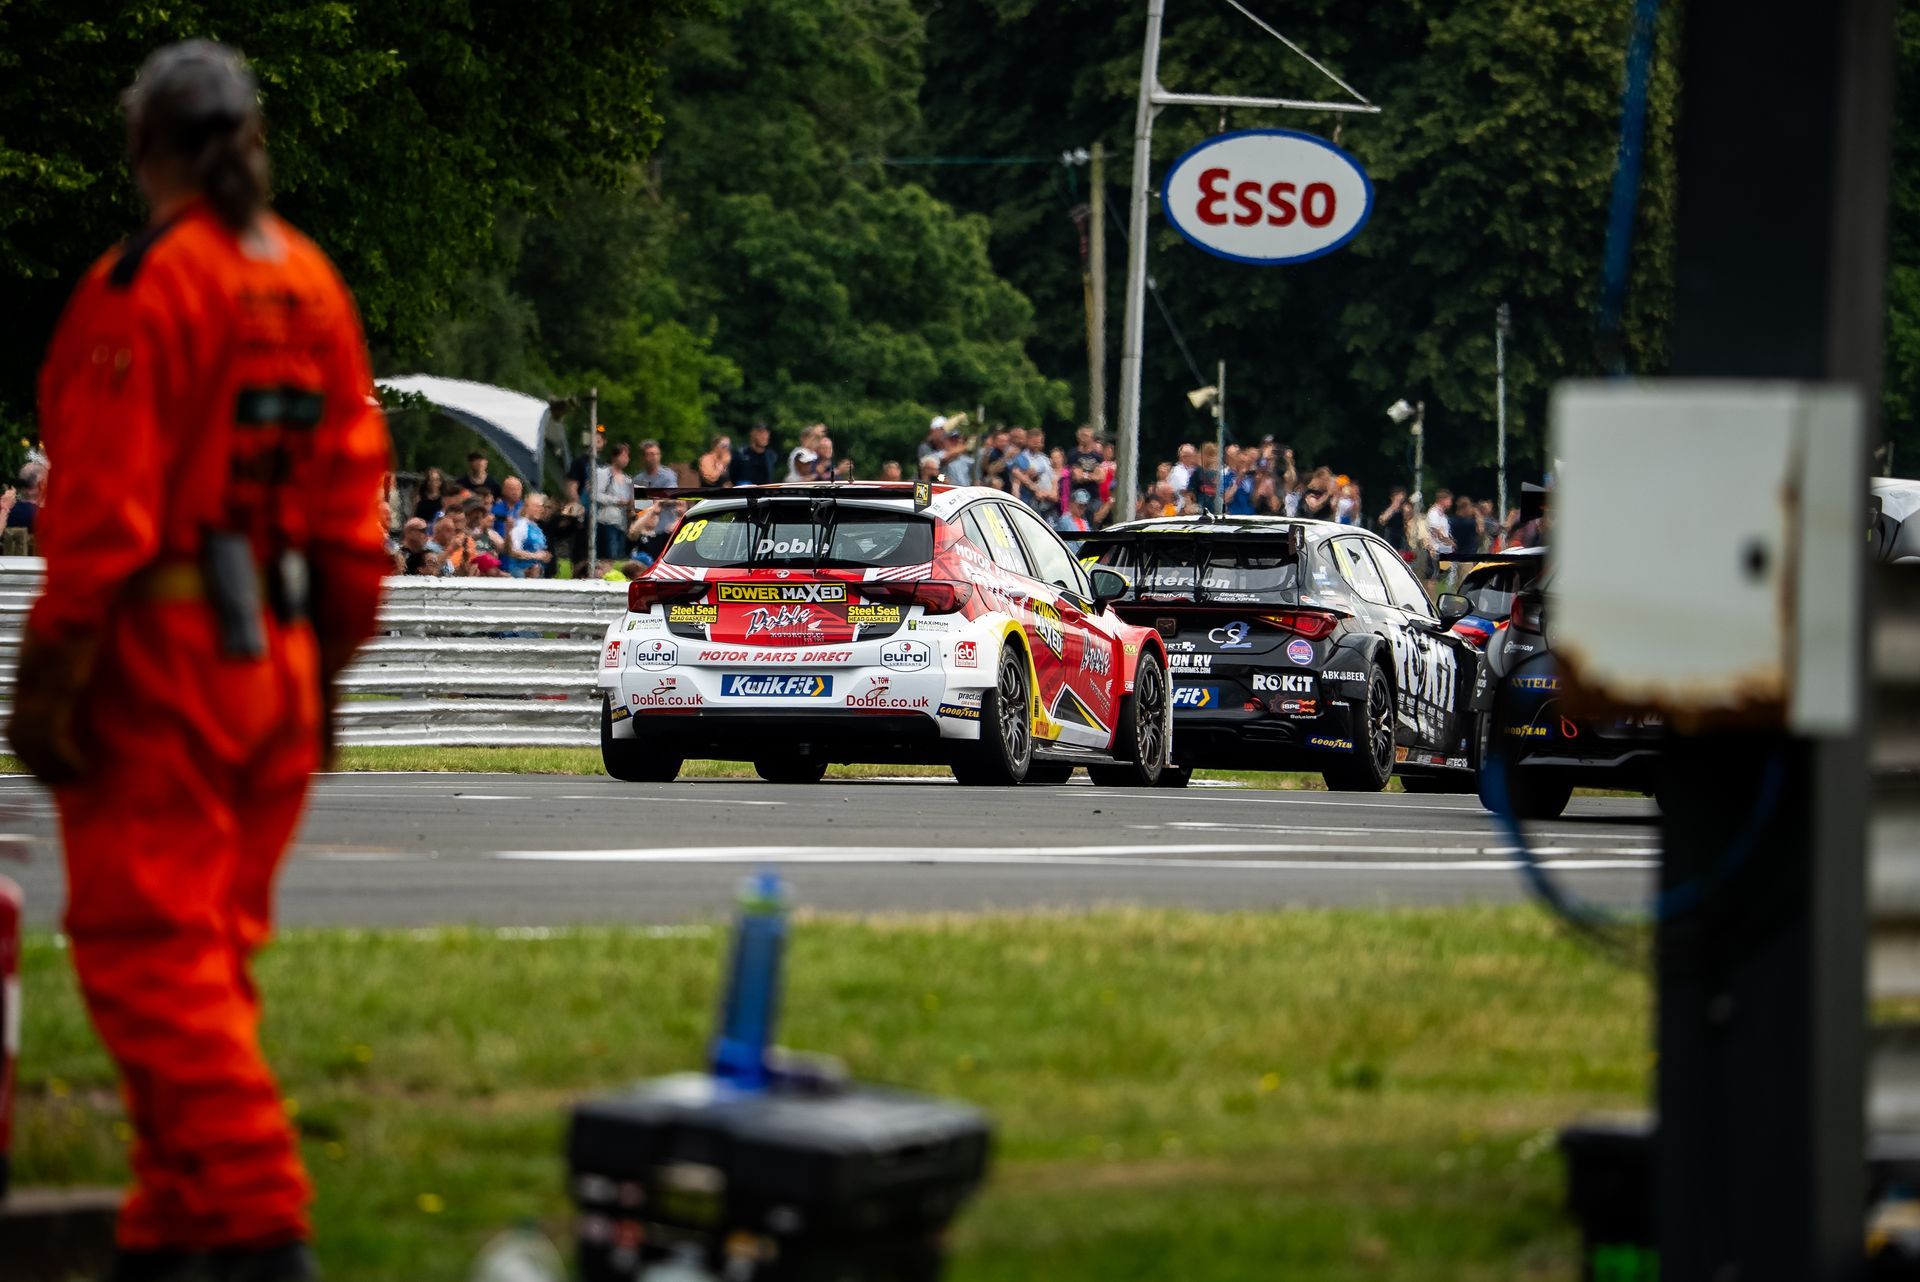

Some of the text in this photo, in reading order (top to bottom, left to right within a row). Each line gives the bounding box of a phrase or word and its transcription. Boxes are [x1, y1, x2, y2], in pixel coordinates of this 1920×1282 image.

[1196, 168, 1336, 228] Esso
[674, 519, 709, 544] 88
[757, 539, 830, 554] Doble
[1127, 573, 1230, 588] tterson
[721, 587, 779, 599] POWER
[671, 605, 717, 615] Steel Seal
[848, 606, 900, 616] Steel Seal
[638, 650, 675, 662] eurol
[699, 651, 853, 662] MOTOR PARTS DIRECT
[883, 651, 927, 662] eurol
[1193, 654, 1212, 667] RV
[1322, 670, 1366, 682] ABK BEER
[632, 694, 703, 706] Doble.co.uk
[846, 695, 929, 708] Doble.co.uk
